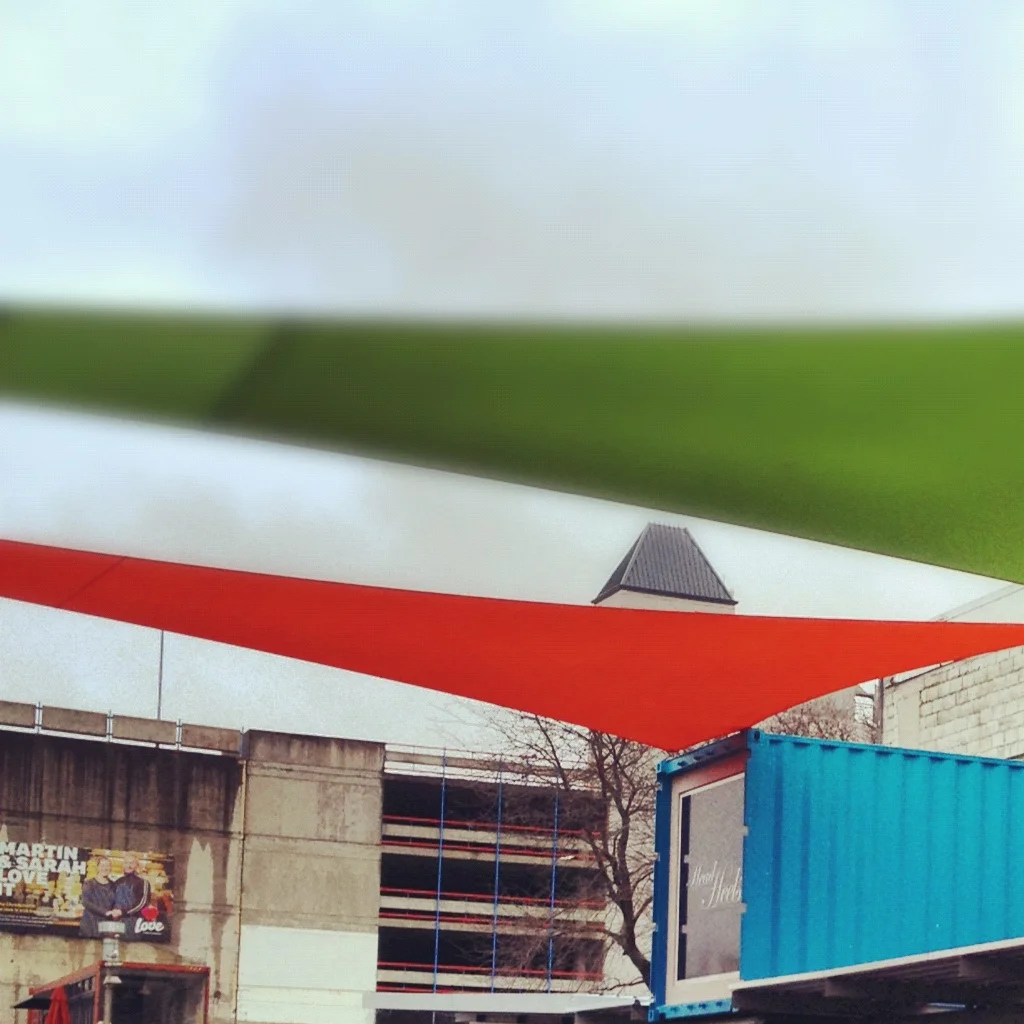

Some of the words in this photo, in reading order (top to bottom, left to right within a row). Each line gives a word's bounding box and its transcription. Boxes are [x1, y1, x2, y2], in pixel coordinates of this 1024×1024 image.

[0, 841, 78, 860] MARTIN
[16, 856, 87, 876] SARAH
[134, 917, 165, 934] Love
